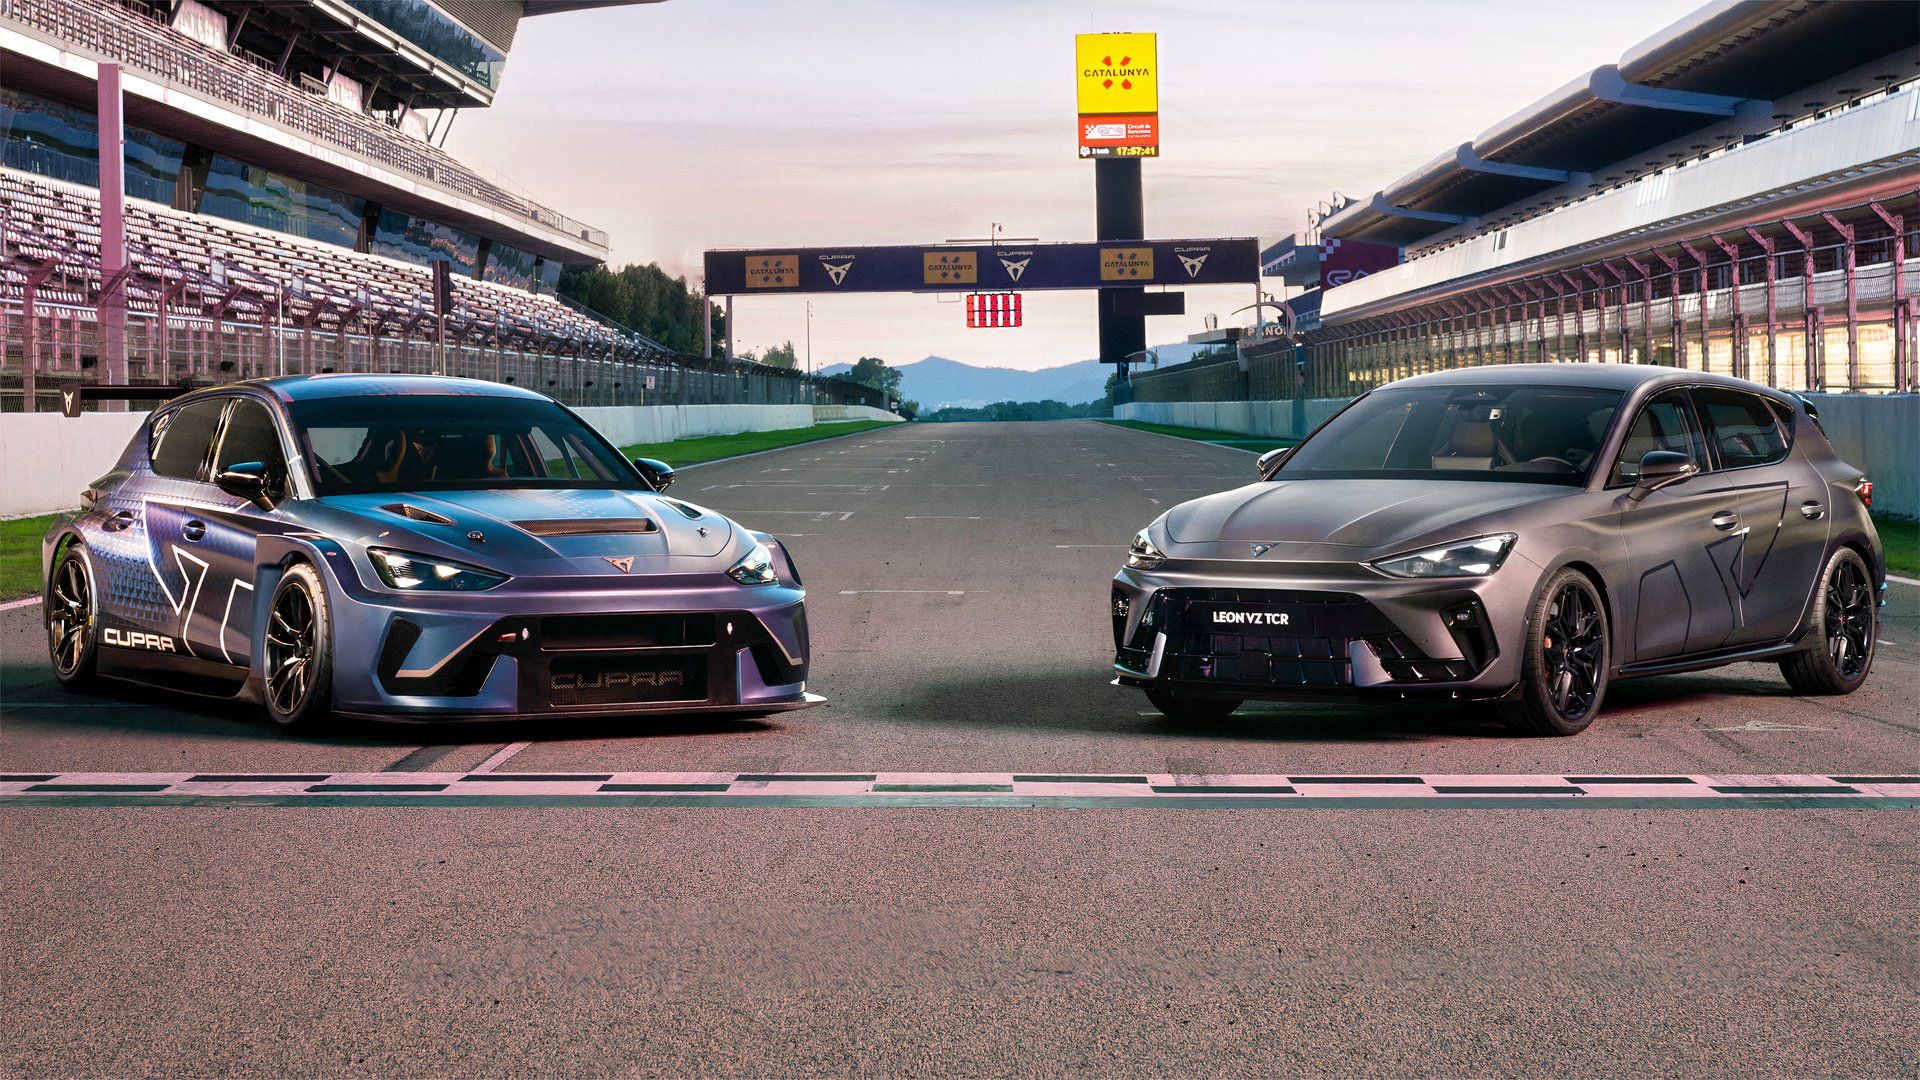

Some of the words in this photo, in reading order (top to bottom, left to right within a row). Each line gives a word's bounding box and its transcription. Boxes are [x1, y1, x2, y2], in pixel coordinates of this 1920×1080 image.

[1084, 69, 1149, 77] CATALUNYA
[1116, 146, 1155, 155] 17:57:41
[928, 264, 973, 272] CATALUNYA
[1104, 260, 1150, 268] CATALUNYA
[750, 267, 795, 275] CATALUNYA
[1213, 611, 1245, 624] LEON
[1246, 612, 1263, 624] VZ
[1264, 613, 1289, 625] TCR
[104, 628, 176, 652] CUPRA
[551, 671, 683, 689] CUPRA
